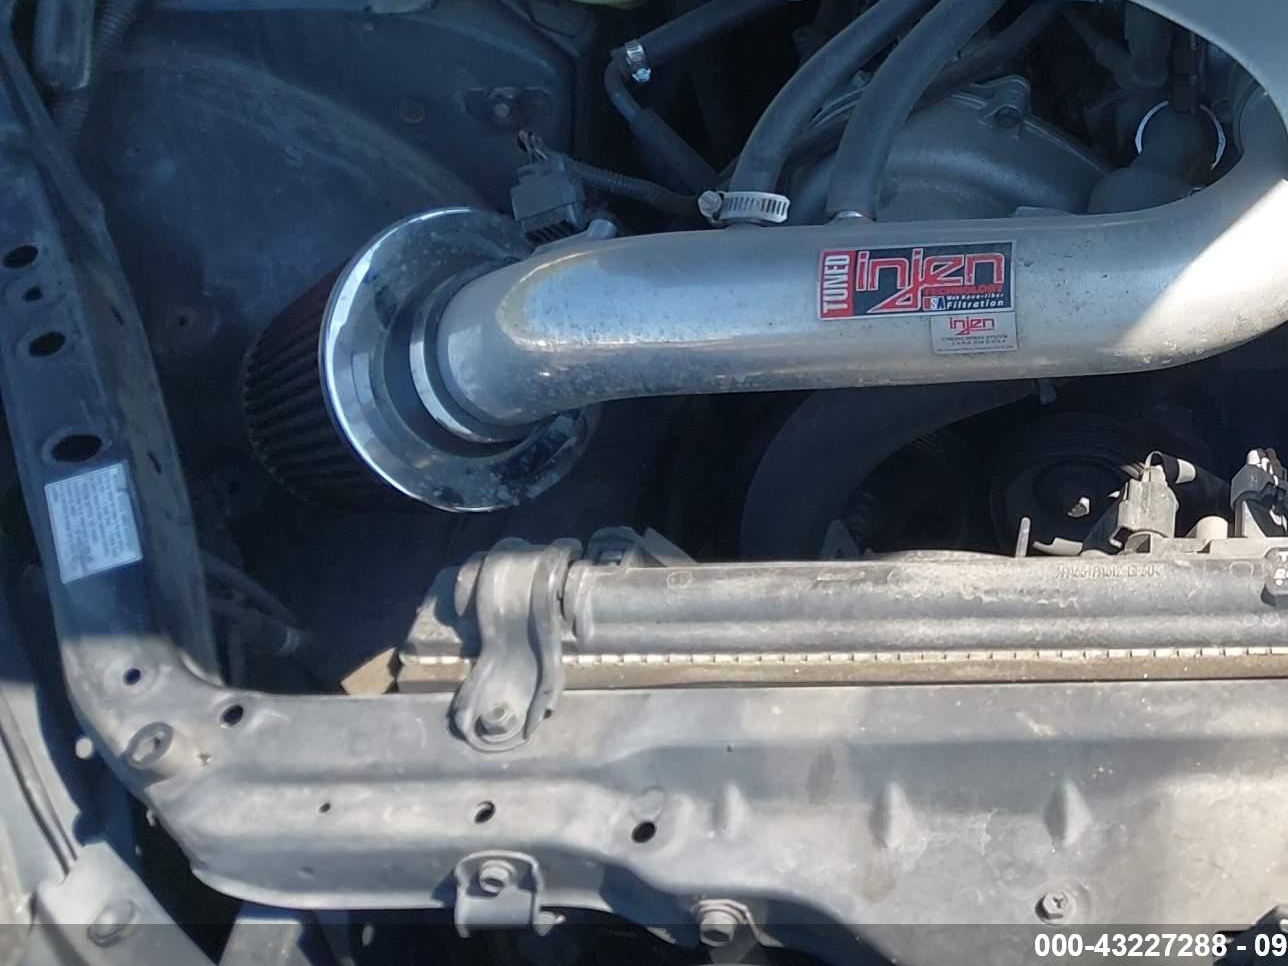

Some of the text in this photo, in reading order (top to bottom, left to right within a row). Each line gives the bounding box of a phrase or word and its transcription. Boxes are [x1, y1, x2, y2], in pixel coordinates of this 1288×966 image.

[823, 254, 851, 314] TUNED
[855, 248, 1006, 313] injen
[946, 299, 1004, 310] Filtration
[949, 315, 995, 335] injen
